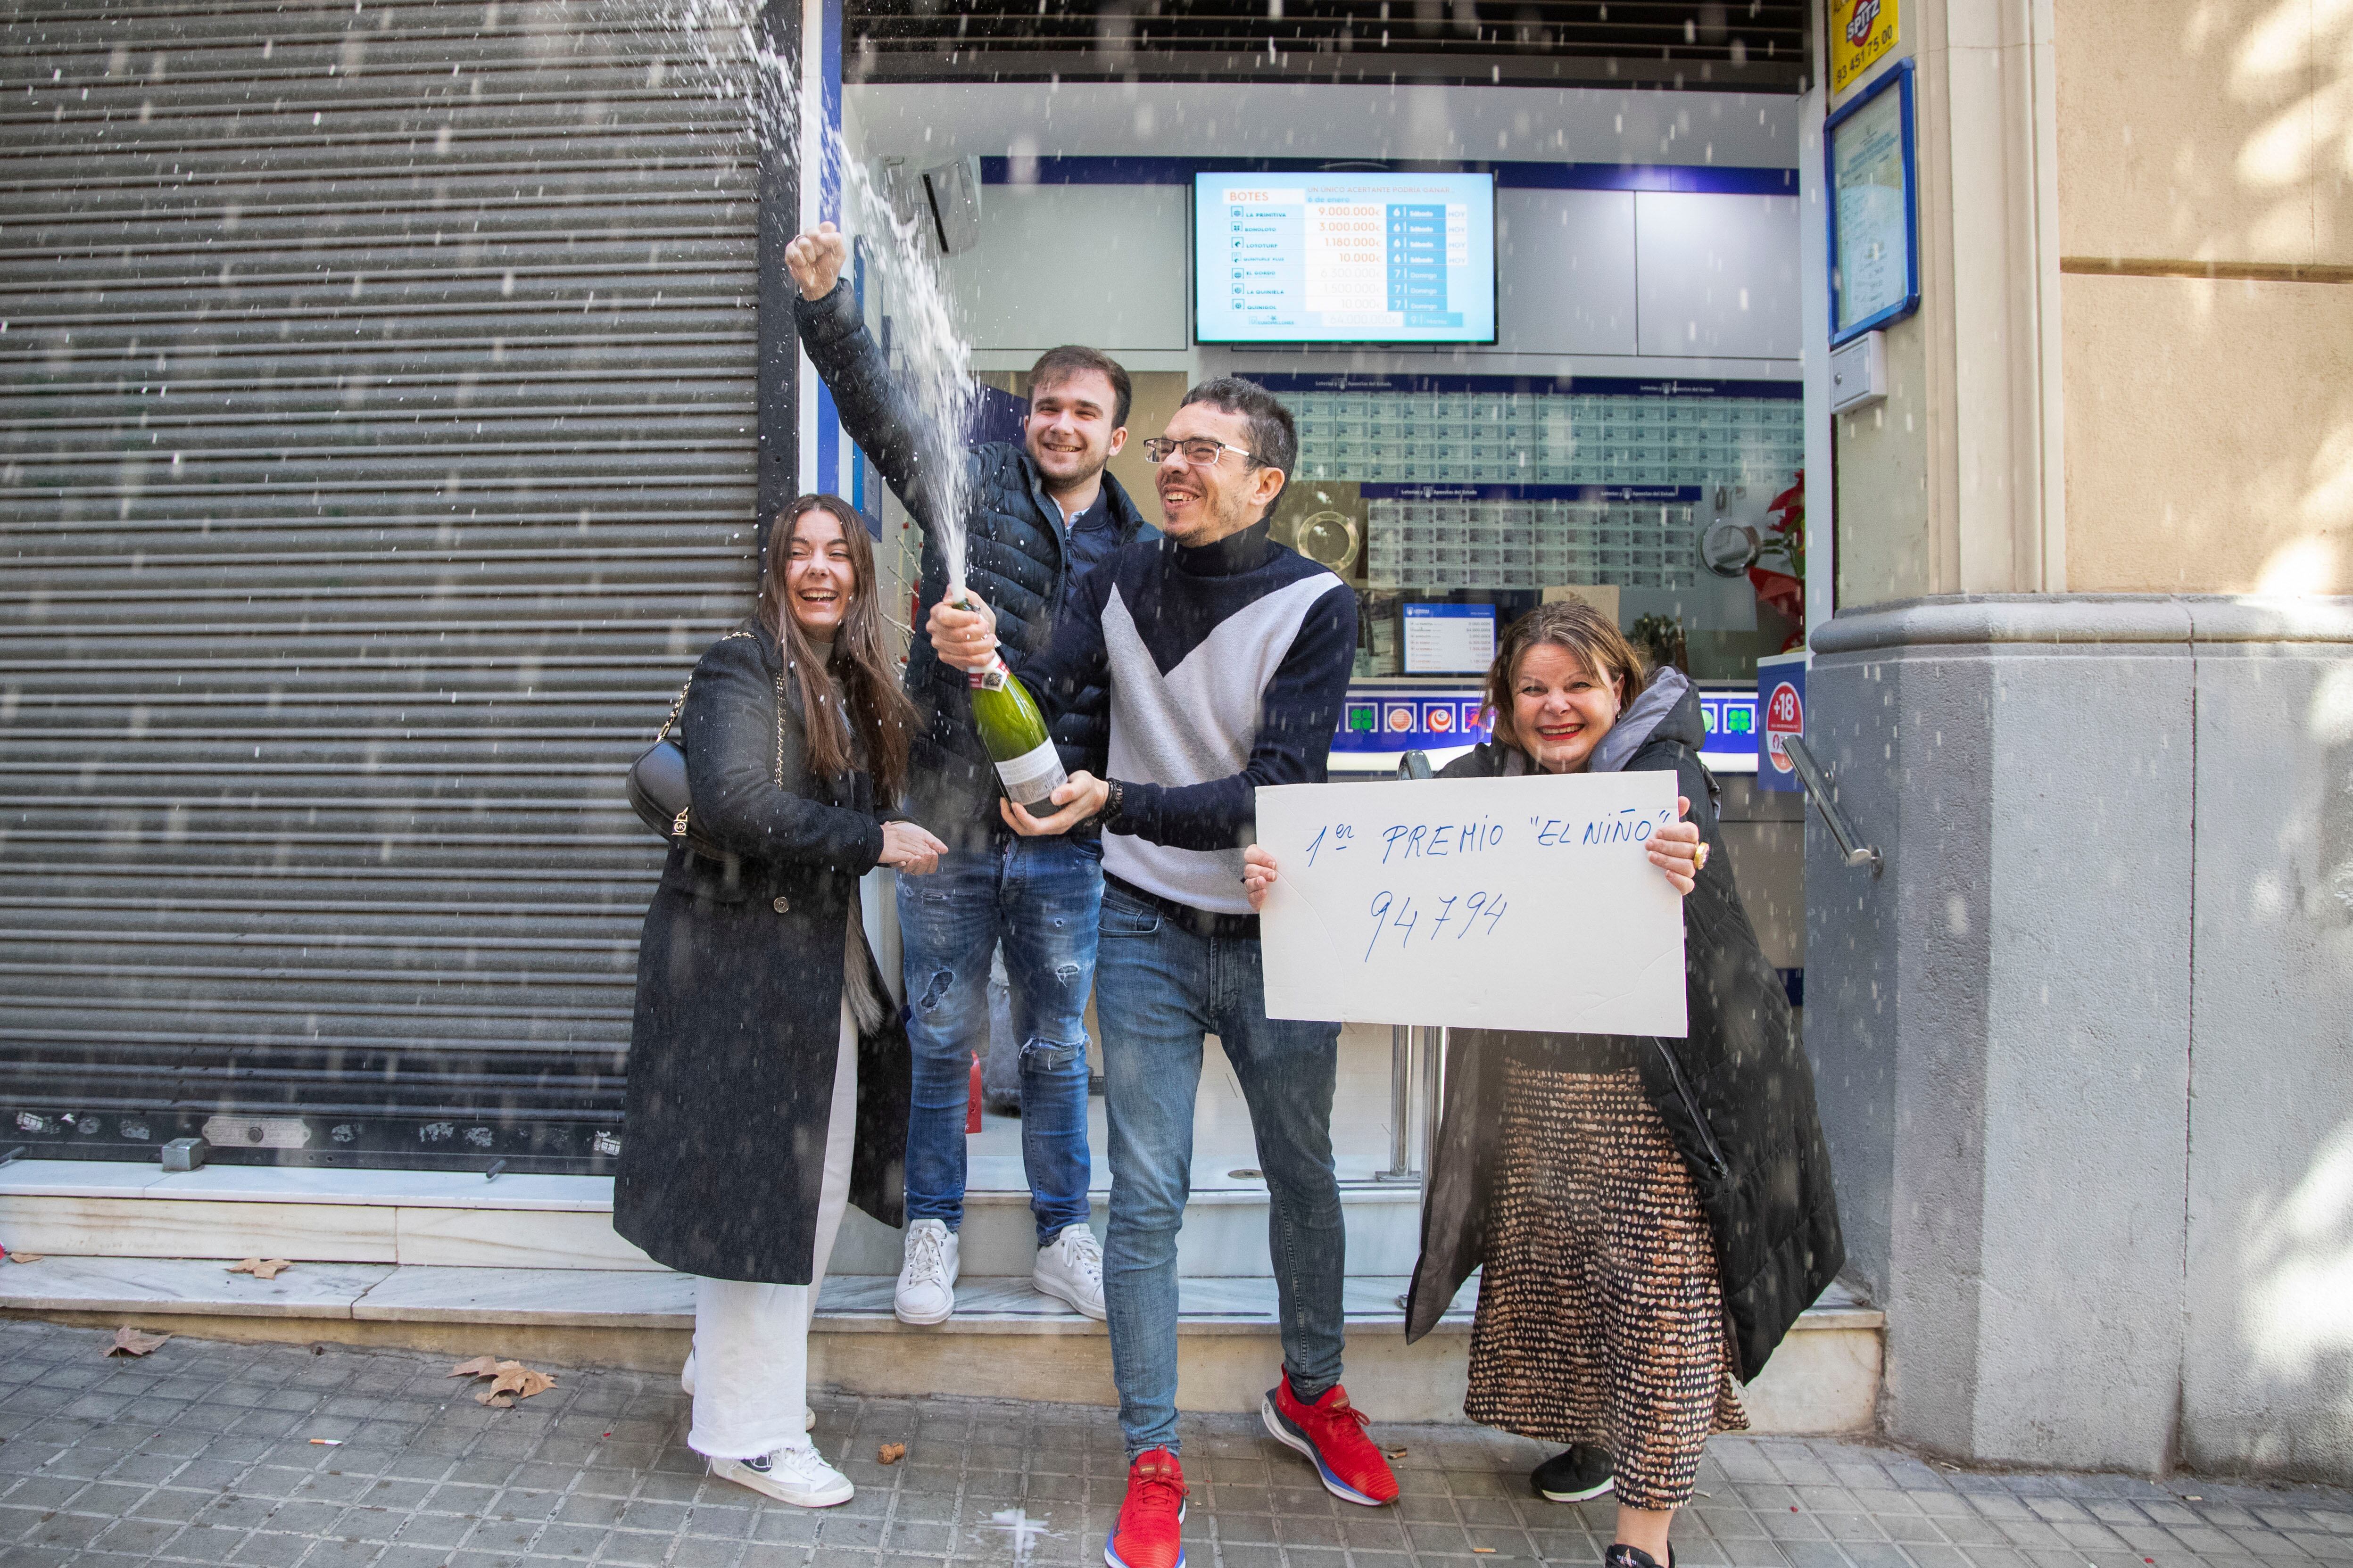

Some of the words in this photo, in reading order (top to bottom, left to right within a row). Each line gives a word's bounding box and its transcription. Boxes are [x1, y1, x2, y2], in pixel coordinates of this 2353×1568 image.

[1230, 192, 1268, 201] BOTES
[1393, 208, 1400, 216] 6
[1393, 223, 1400, 232] 6
[1393, 239, 1400, 248] 6
[1394, 254, 1401, 263] 6
[1394, 270, 1401, 278] 7
[1394, 285, 1401, 294] 7
[1394, 300, 1401, 309] 7
[1773, 693, 1794, 721] +18
[1383, 815, 1504, 865] PREMIO
[1365, 891, 1507, 963] 94794
